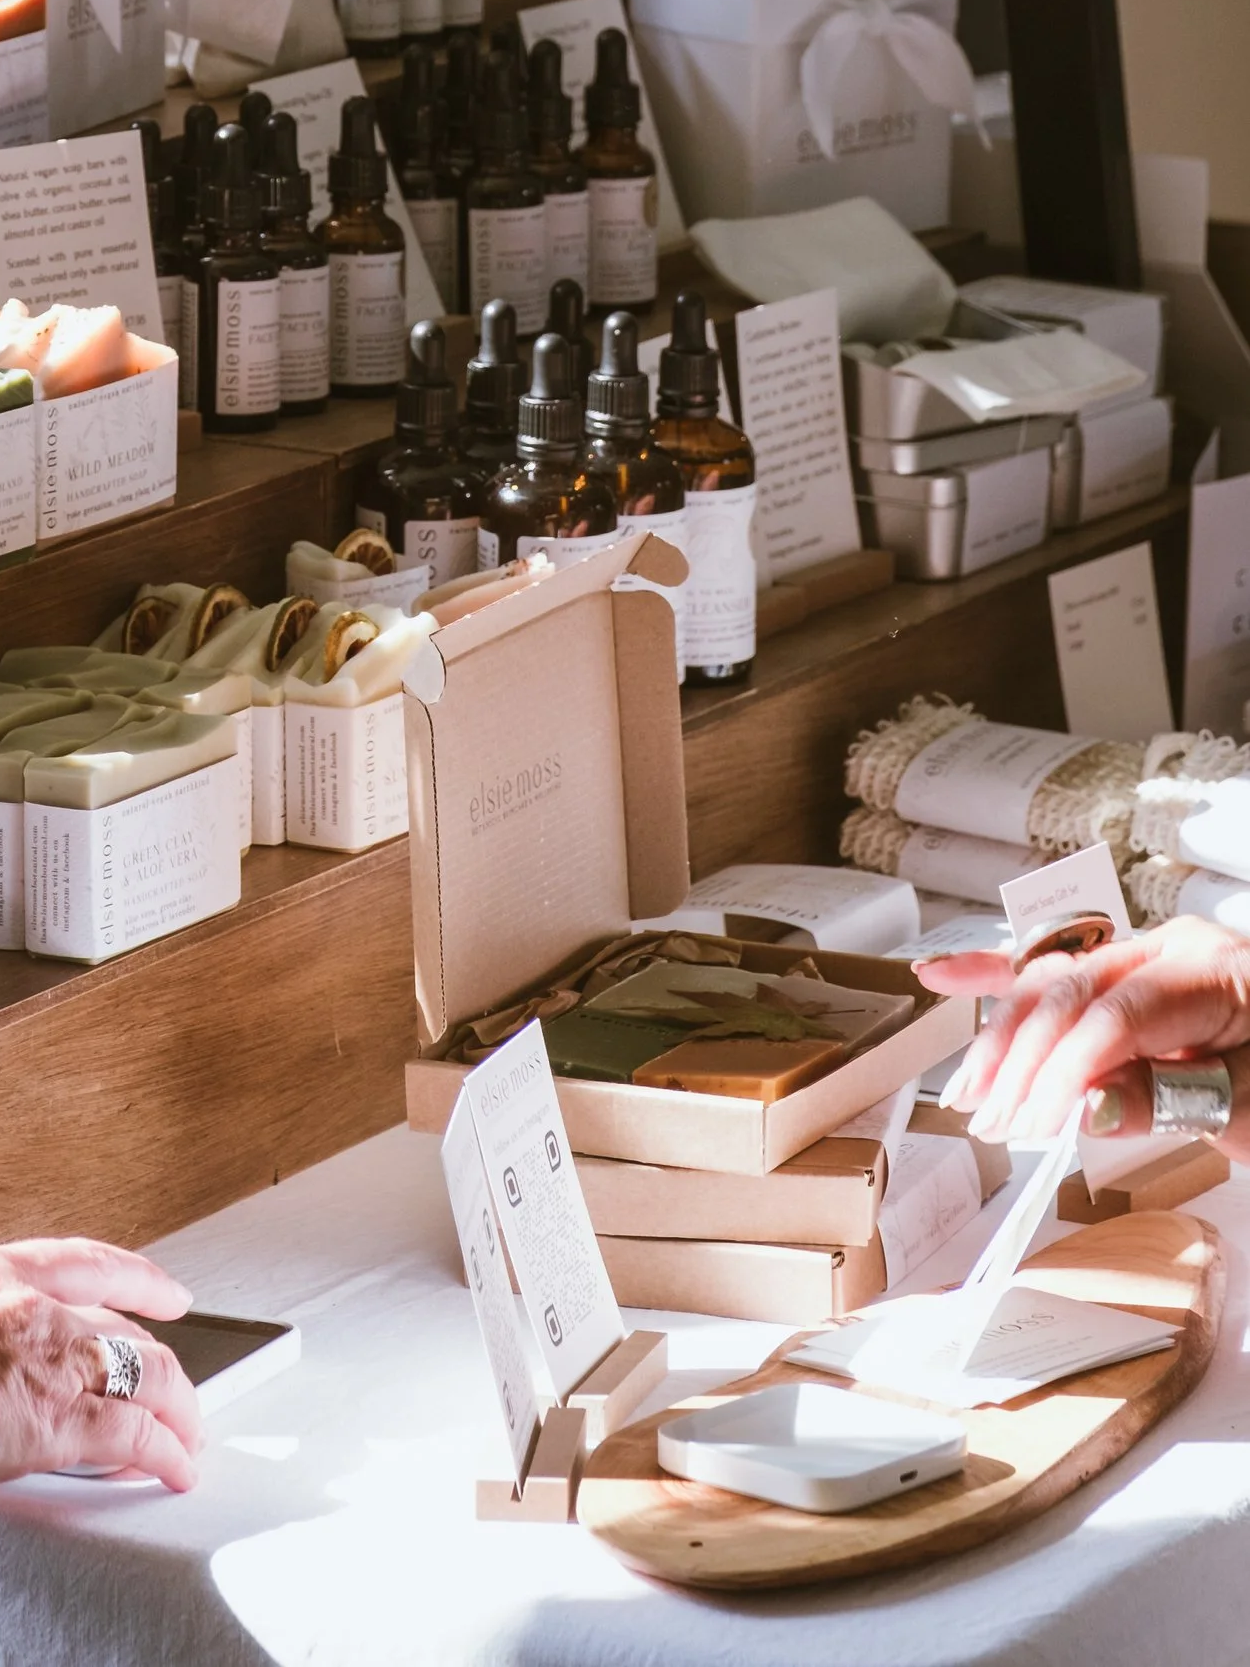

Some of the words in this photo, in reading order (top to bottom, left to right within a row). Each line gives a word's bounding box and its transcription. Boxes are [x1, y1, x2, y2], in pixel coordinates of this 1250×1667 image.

[6, 255, 41, 270] Scented
[226, 289, 242, 348] moss
[46, 406, 58, 470] moss
[66, 458, 102, 483] WILD
[107, 441, 156, 471] MEADOW
[43, 473, 58, 530] elsie
[66, 475, 127, 504] HANDCRAFTED
[329, 732, 338, 769] facebook
[365, 713, 375, 774] moss
[330, 782, 338, 826] instagram
[363, 780, 377, 836] elsie
[469, 775, 512, 823] elsie
[516, 752, 562, 798] moss
[61, 833, 70, 873] facebook
[102, 815, 113, 880] moss
[123, 844, 161, 869] GREEN
[165, 830, 194, 852] CLAY
[123, 876, 130, 887] &
[137, 858, 165, 882] ALOE
[170, 846, 199, 869] VERA
[62, 877, 70, 886] &
[1038, 893, 1056, 910] Soap
[1055, 886, 1069, 901] Gift
[62, 887, 70, 933] instagram
[100, 887, 115, 945] elsie
[480, 1074, 511, 1118] elsie
[510, 1050, 542, 1094] moss
